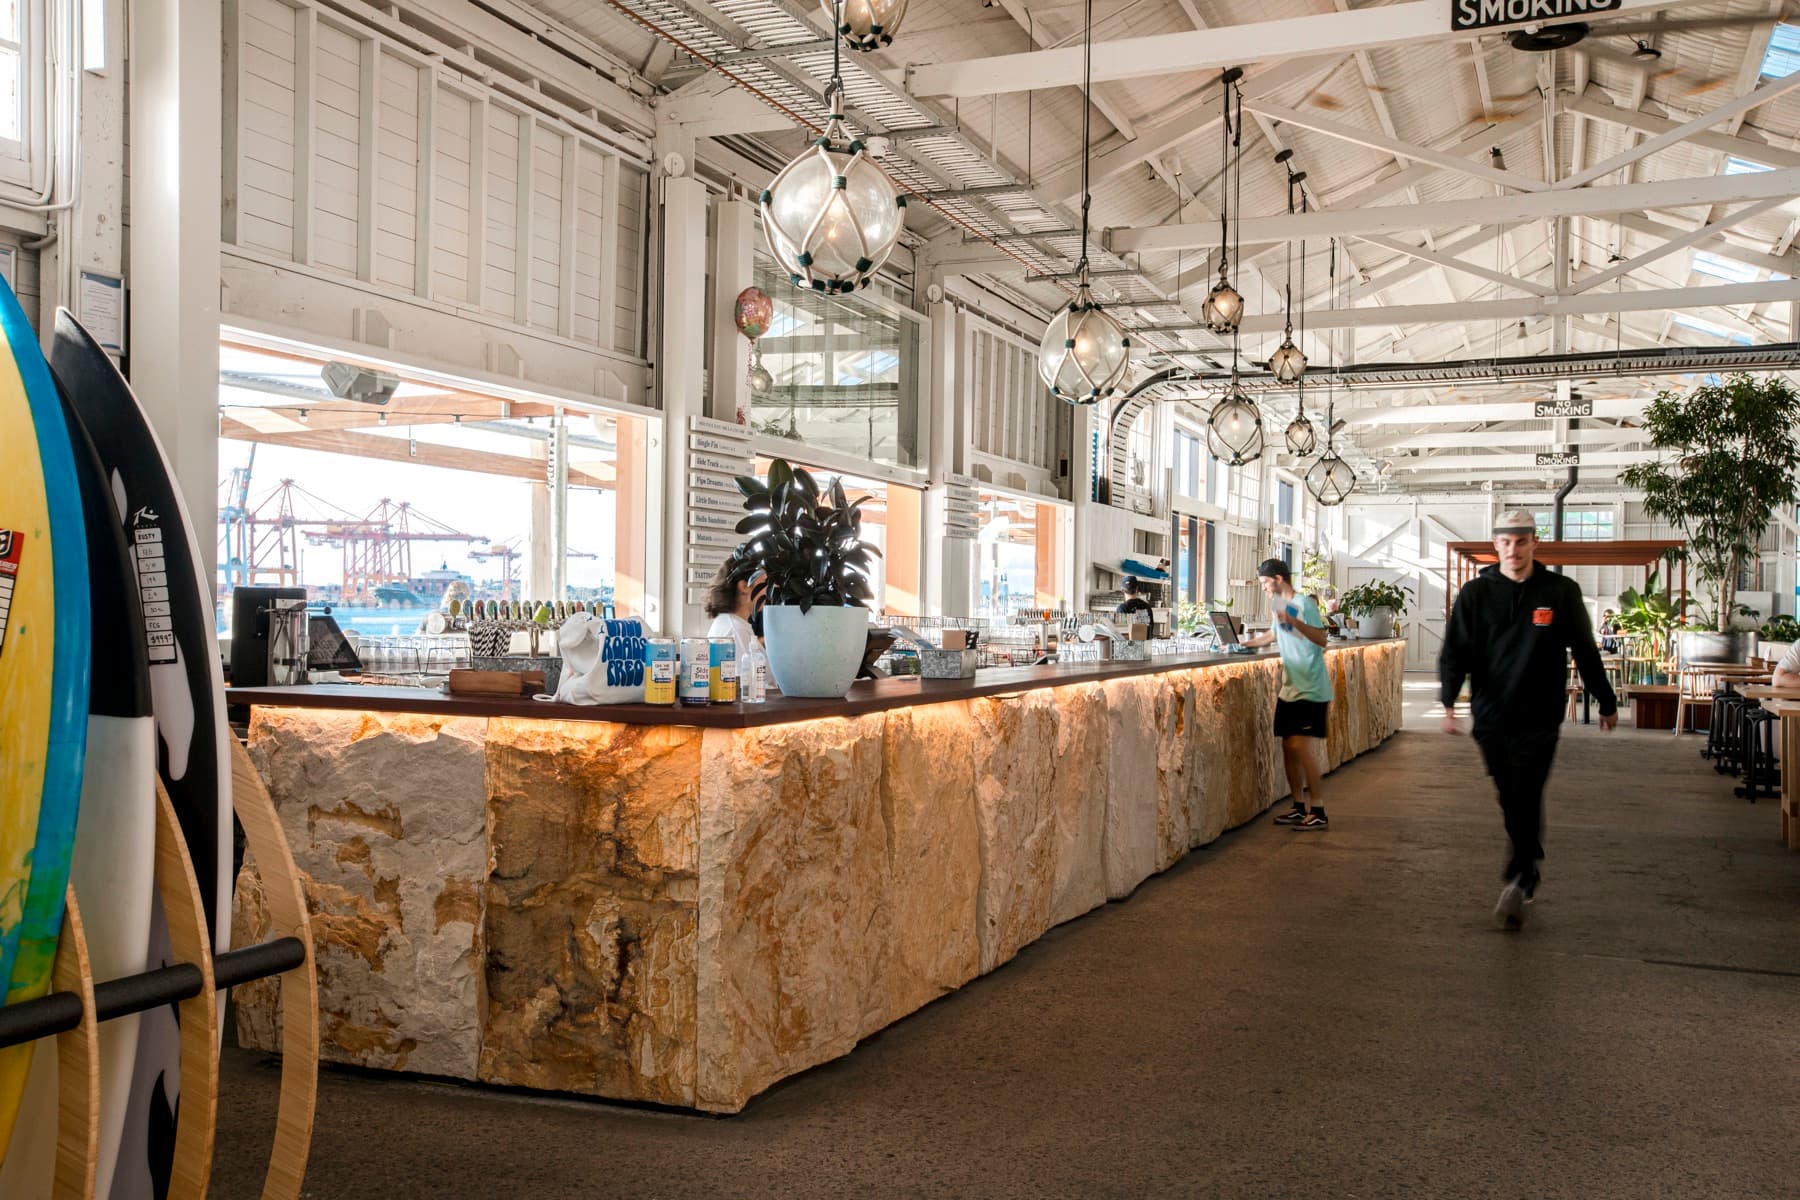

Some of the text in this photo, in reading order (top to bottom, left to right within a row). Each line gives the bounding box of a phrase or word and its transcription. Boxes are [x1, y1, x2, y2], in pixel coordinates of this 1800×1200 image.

[1458, 0, 1611, 25] SMOKI
[1537, 404, 1590, 416] SMOKING
[1537, 455, 1578, 465] SMOKING
[602, 636, 646, 663] ROADS
[607, 660, 645, 687] FREO
